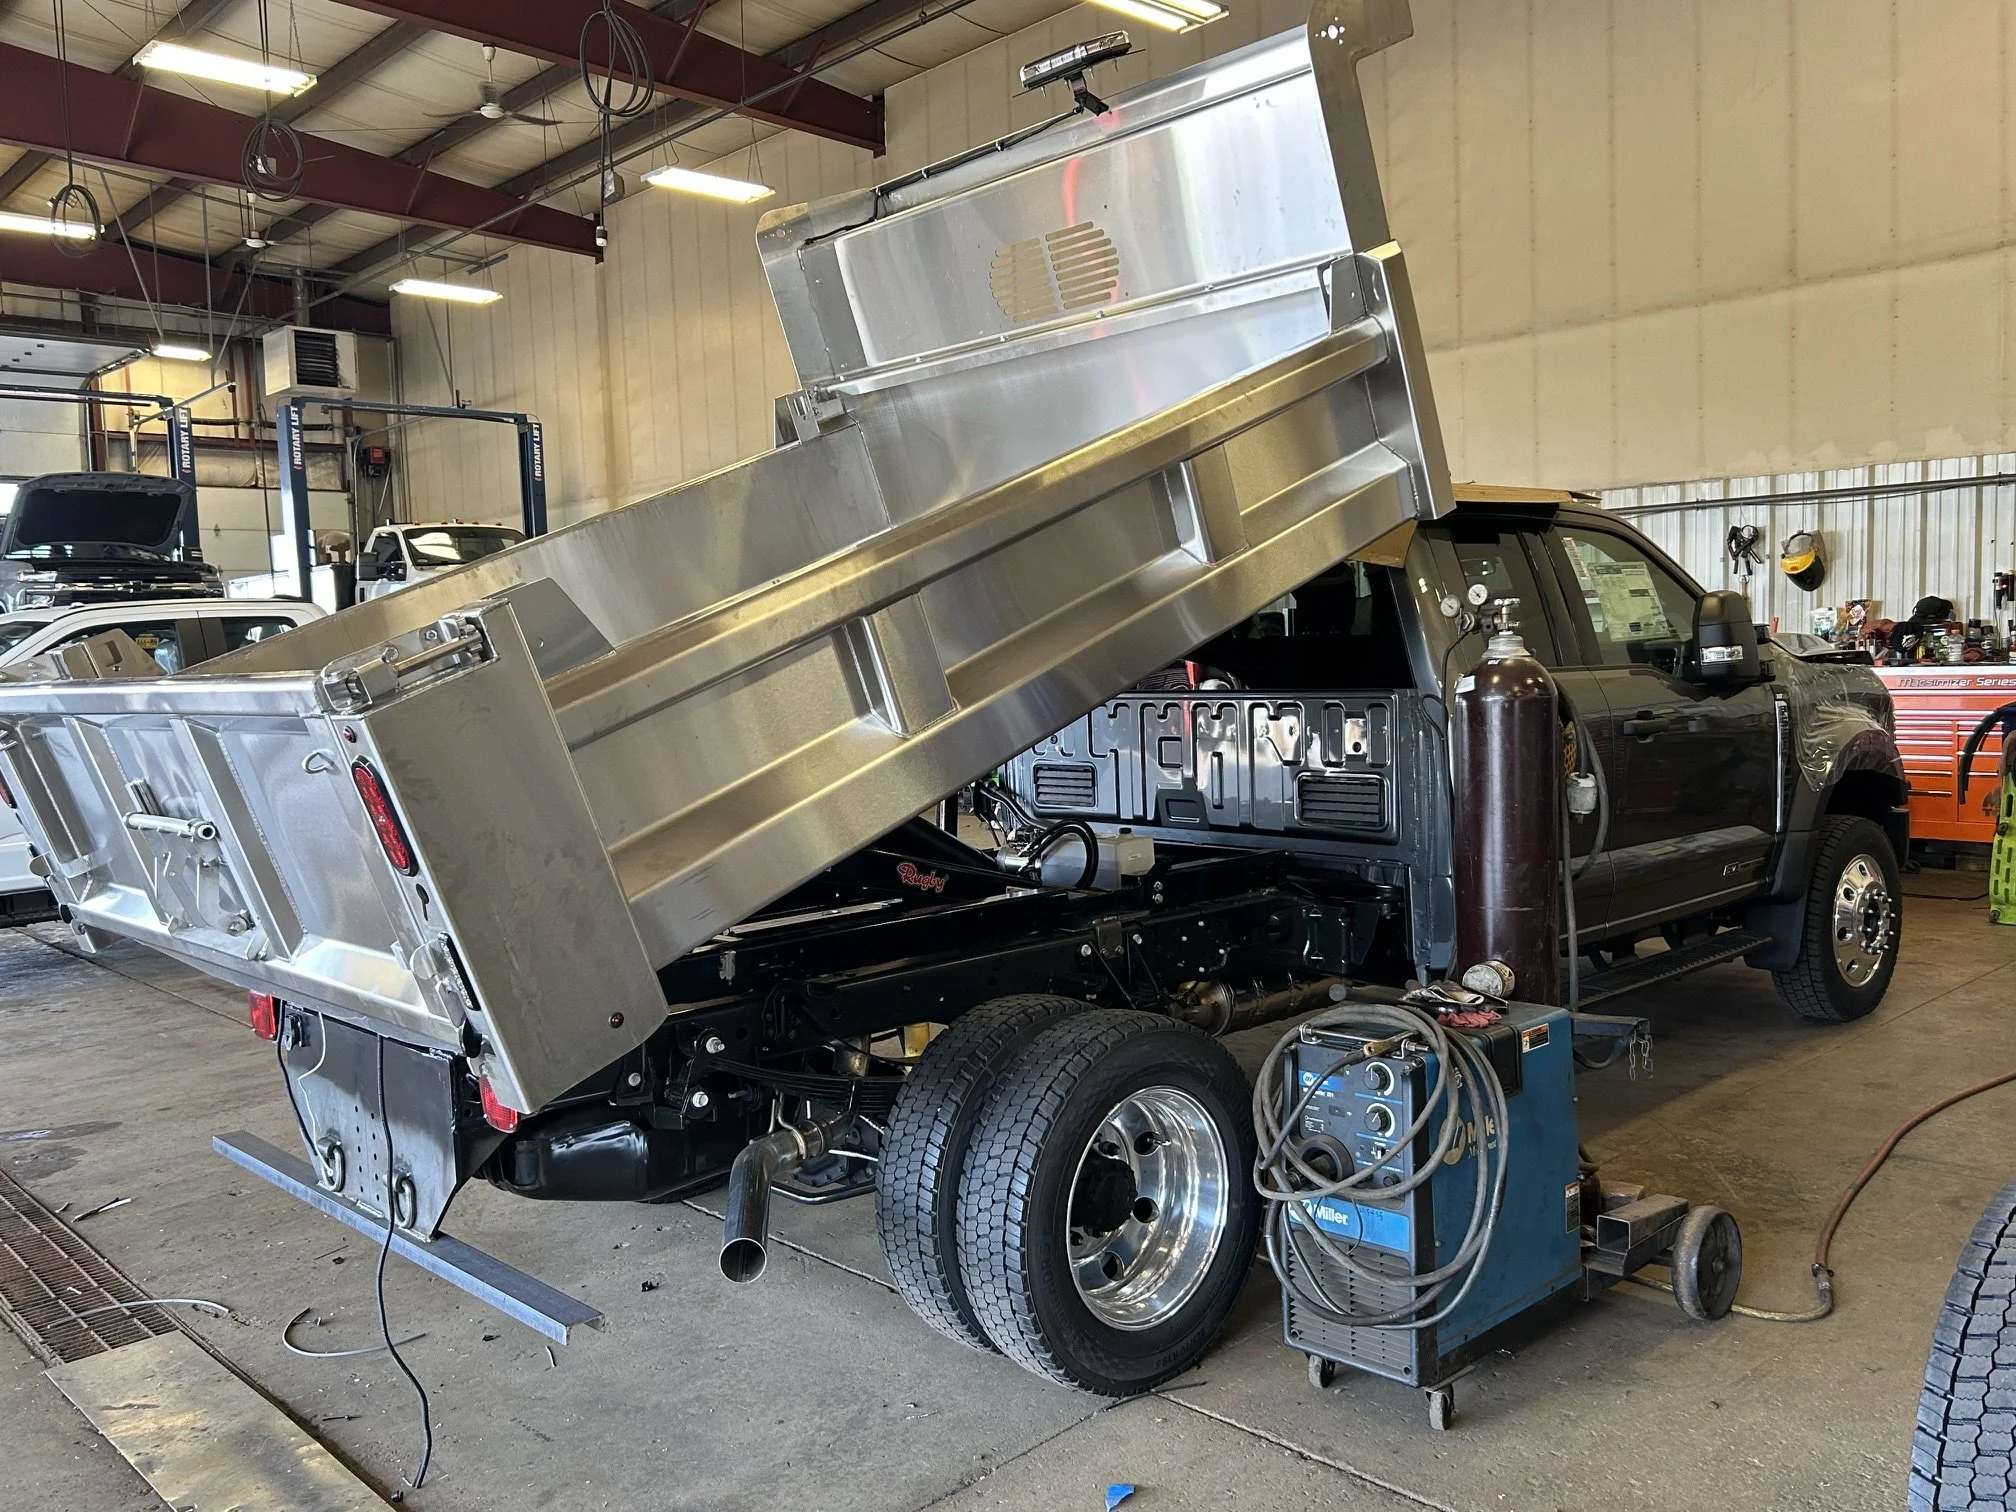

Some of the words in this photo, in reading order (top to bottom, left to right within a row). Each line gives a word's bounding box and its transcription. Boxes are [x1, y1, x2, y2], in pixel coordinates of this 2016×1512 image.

[179, 408, 189, 428] LIFT
[290, 406, 299, 426] LIFT
[181, 430, 191, 468] ROTARY
[292, 428, 302, 465] ROTARY
[534, 443, 542, 477] ROTARY
[1897, 677, 1973, 688] Macsimizer
[1976, 677, 2016, 687] Series
[896, 862, 945, 893] Rugby
[1314, 1204, 1348, 1225] Miller
